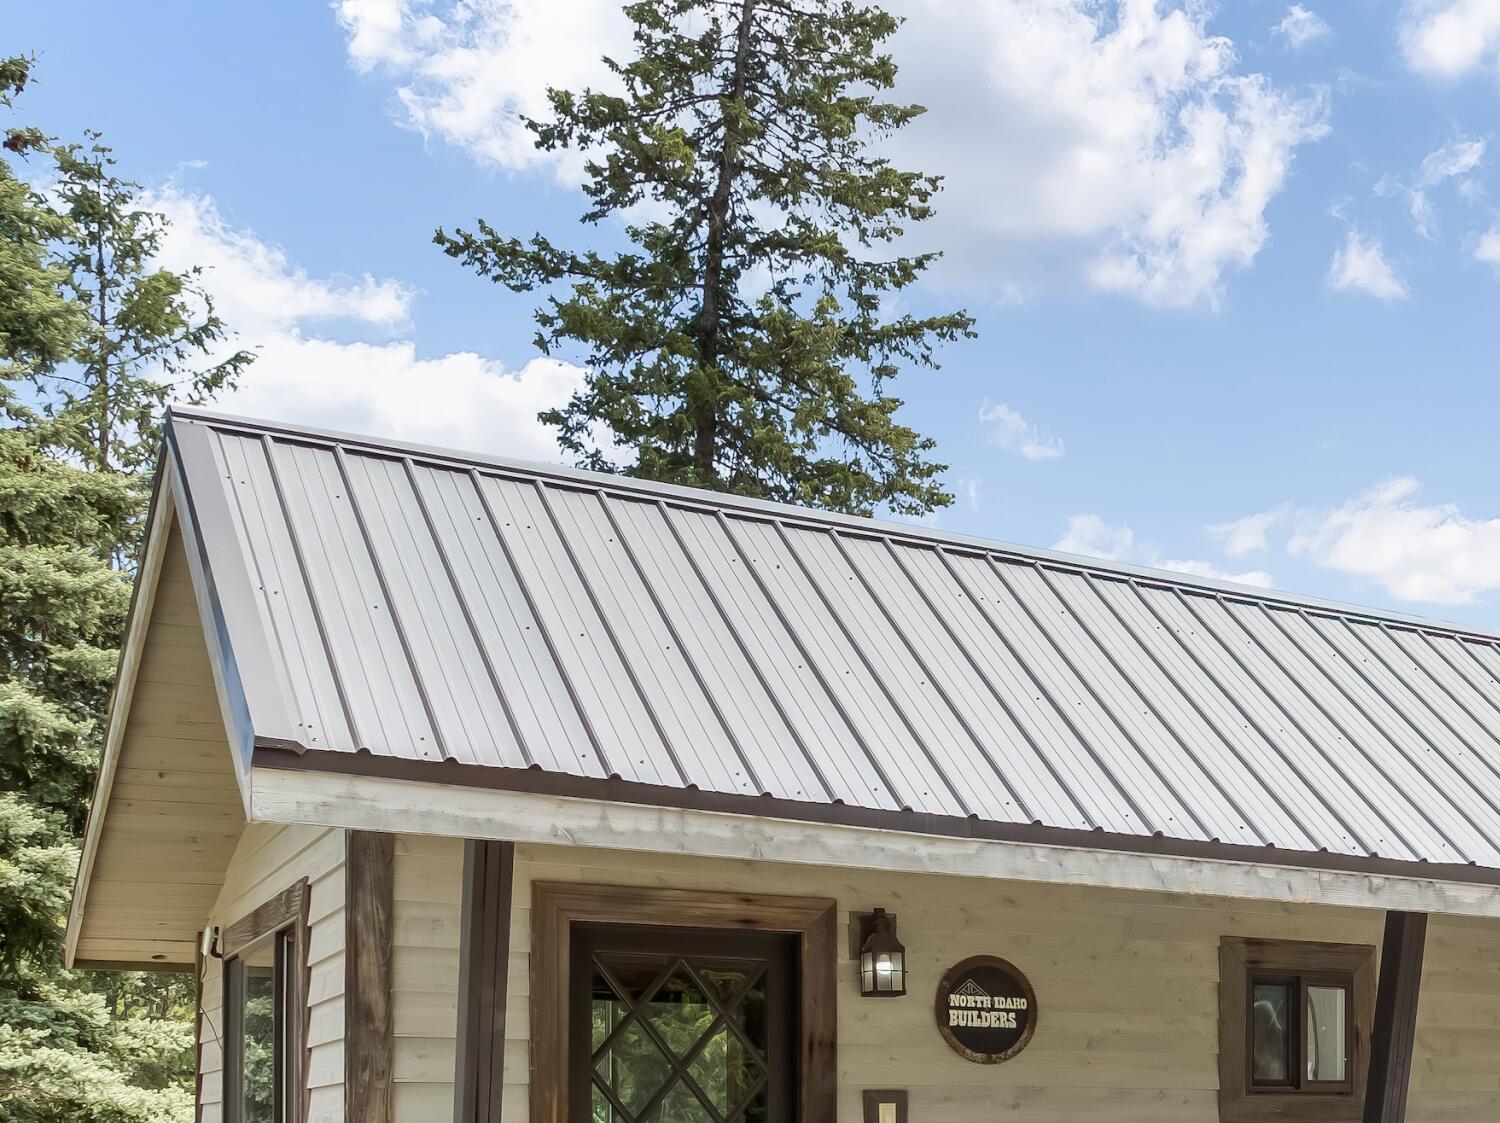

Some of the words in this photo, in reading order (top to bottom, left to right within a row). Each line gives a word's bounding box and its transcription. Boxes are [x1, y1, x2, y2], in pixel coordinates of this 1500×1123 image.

[949, 994, 991, 1008] NORTH
[993, 997, 1027, 1010] IDAHO
[949, 1010, 1017, 1029] BUILDERS
